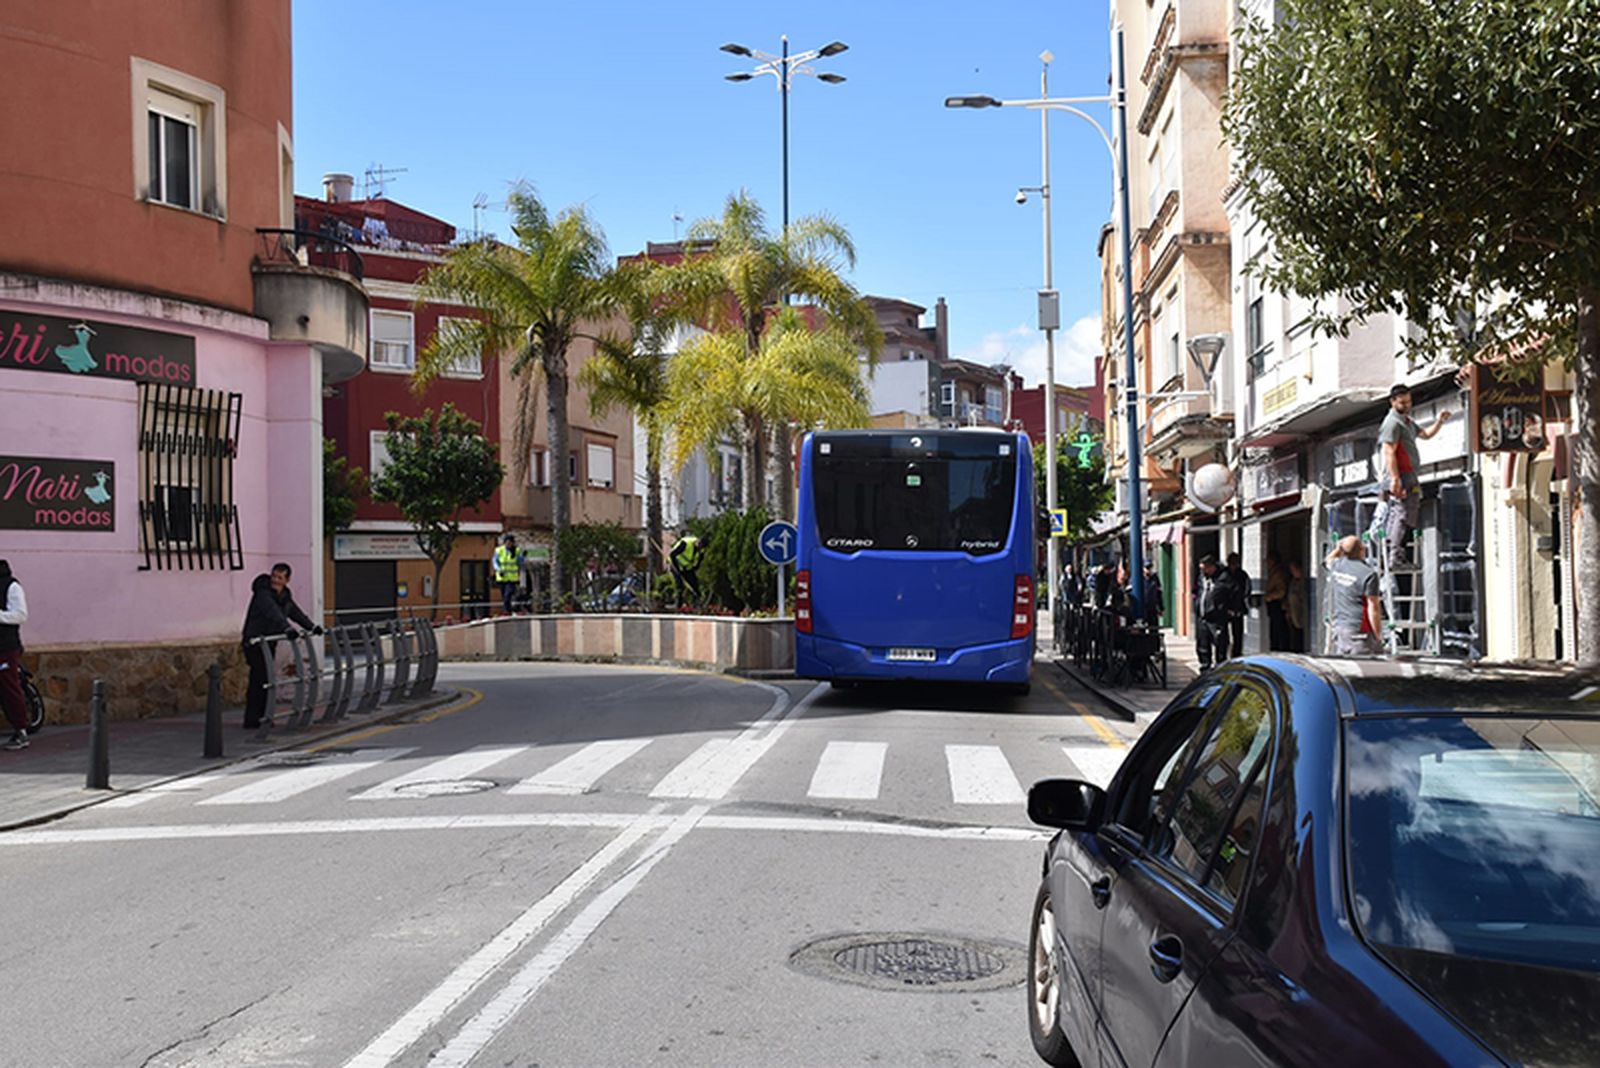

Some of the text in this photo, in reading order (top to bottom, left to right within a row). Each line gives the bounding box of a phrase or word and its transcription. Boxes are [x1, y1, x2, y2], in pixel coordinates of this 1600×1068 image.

[0, 321, 191, 383] ri modas
[0, 463, 81, 505] Nari
[35, 507, 112, 526] modas
[826, 537, 874, 547] CITARO
[960, 540, 1000, 550] hybrid
